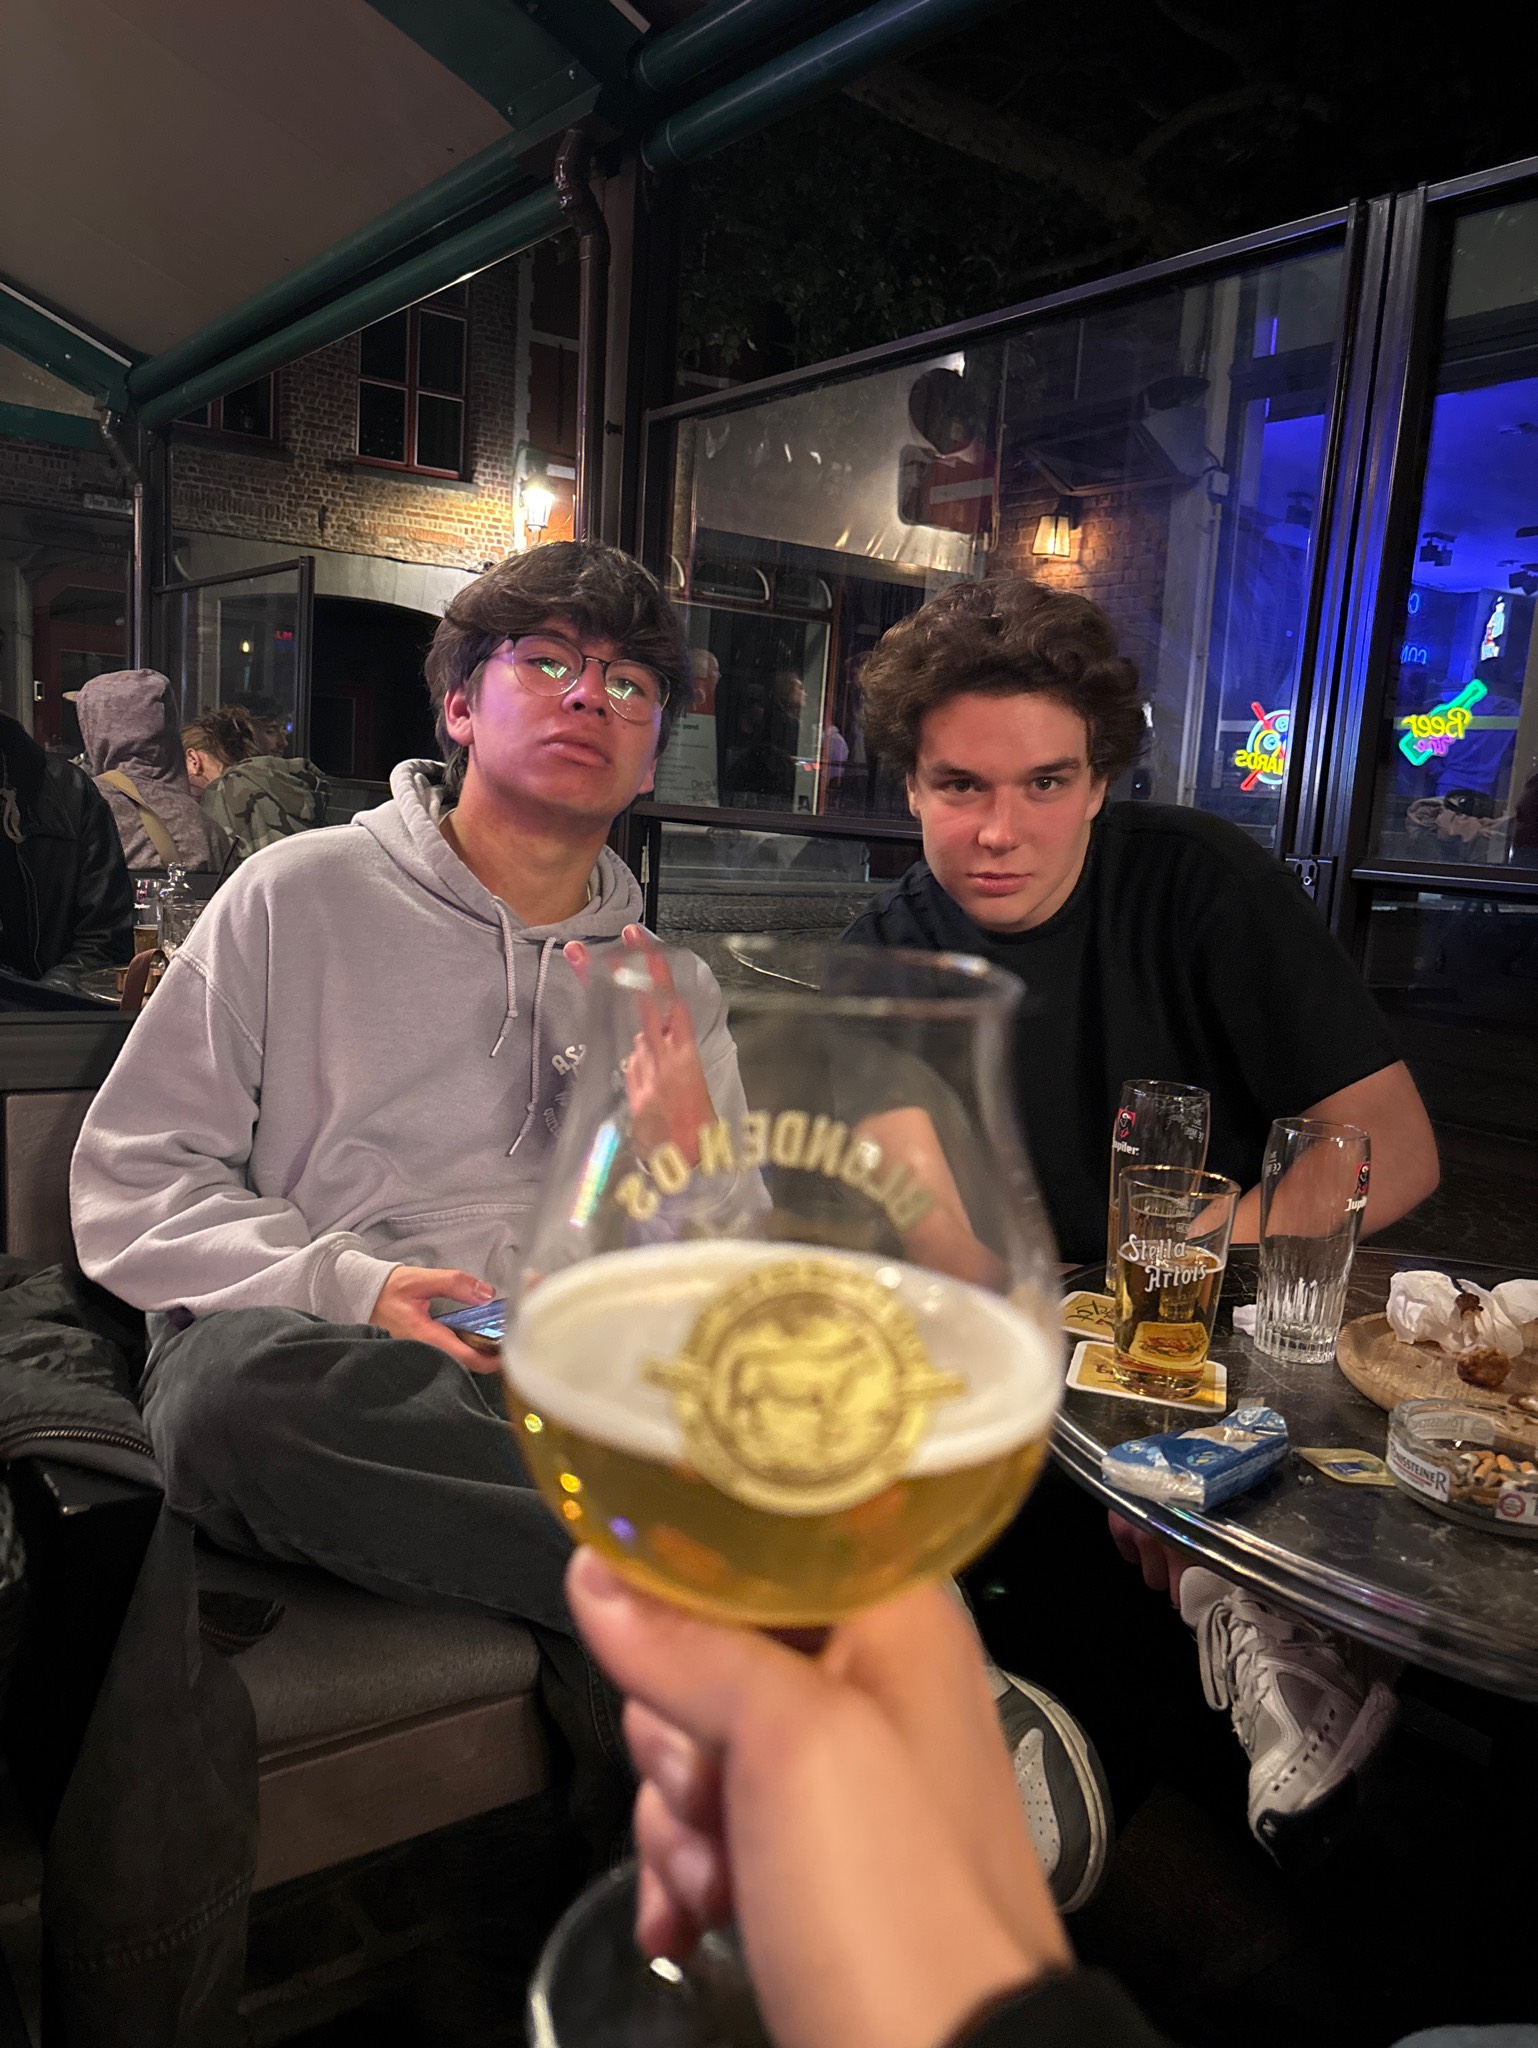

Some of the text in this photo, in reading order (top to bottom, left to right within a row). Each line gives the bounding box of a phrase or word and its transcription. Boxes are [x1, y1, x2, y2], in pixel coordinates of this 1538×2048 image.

[1112, 1140, 1140, 1156] upiler
[1128, 1233, 1186, 1261] Stella
[1144, 1264, 1207, 1293] Artois
